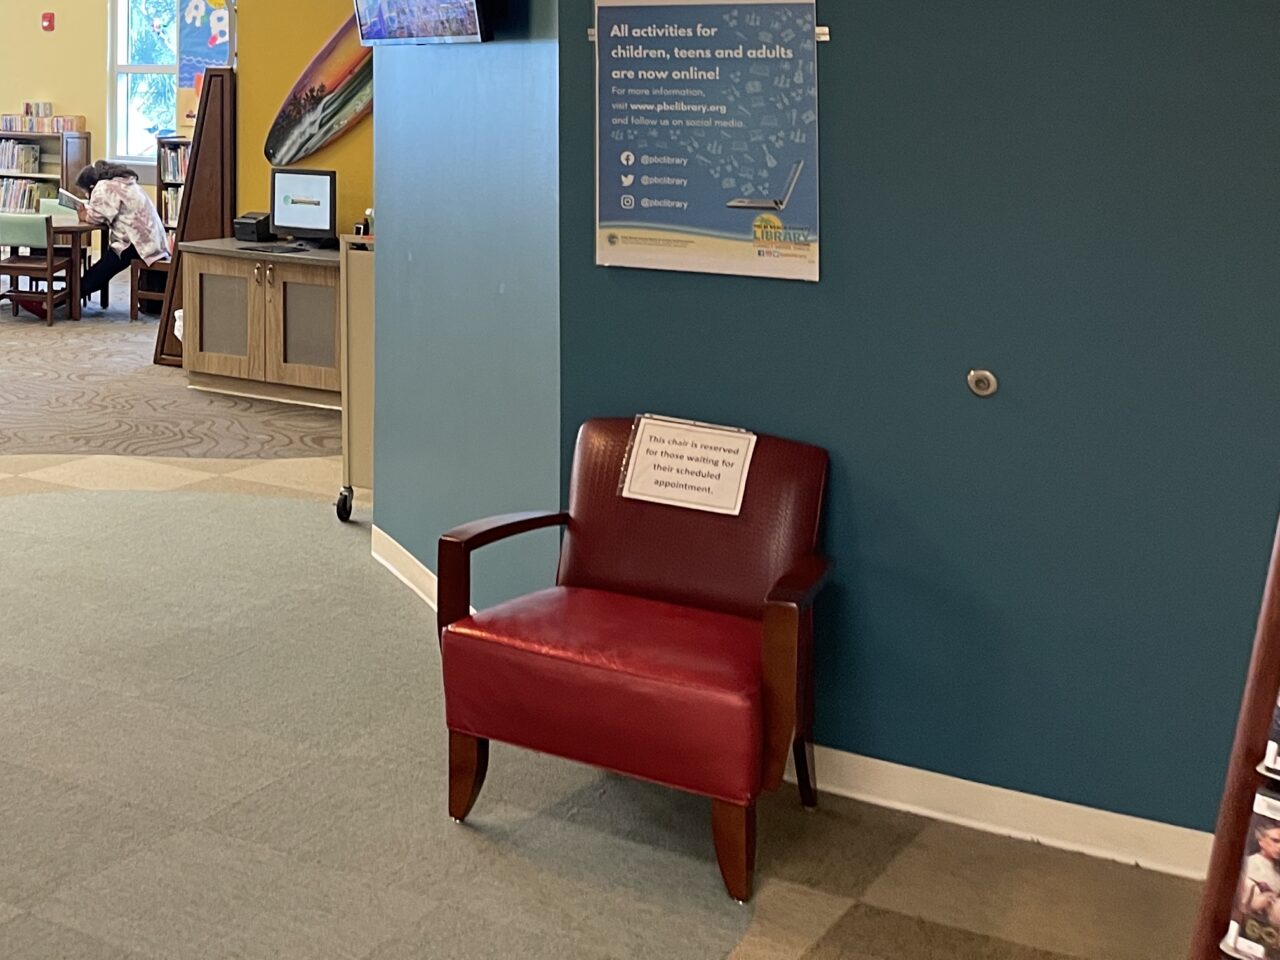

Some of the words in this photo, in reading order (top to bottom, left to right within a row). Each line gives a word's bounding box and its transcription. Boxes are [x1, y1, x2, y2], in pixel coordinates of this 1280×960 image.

[610, 24, 629, 37] All
[632, 24, 693, 38] activities
[696, 24, 718, 37] for
[611, 45, 671, 60] children,
[674, 46, 712, 59] teens
[714, 45, 743, 59] and
[746, 44, 793, 59] adults
[611, 70, 635, 80] are
[638, 70, 669, 80] now
[671, 66, 720, 80] online!
[611, 86, 626, 95] For
[628, 87, 650, 95] more
[652, 86, 706, 97] information,
[611, 102, 628, 110] visit
[630, 102, 727, 114] www.pbclibrary.org
[611, 116, 629, 125] and
[631, 115, 658, 126] follow
[671, 119, 684, 127] on
[685, 118, 712, 128] social
[714, 119, 746, 129] media.
[640, 155, 688, 167] @pbclibrary
[753, 230, 810, 243] LIBRARY
[649, 435, 665, 444] This
[667, 438, 688, 448] chair
[700, 444, 740, 455] reserved
[645, 447, 658, 457] for
[660, 450, 685, 461] those
[687, 455, 719, 466] waiting
[722, 458, 735, 468] for
[653, 463, 674, 473] their
[676, 467, 721, 480] scheduled
[654, 479, 713, 494] appointment.
